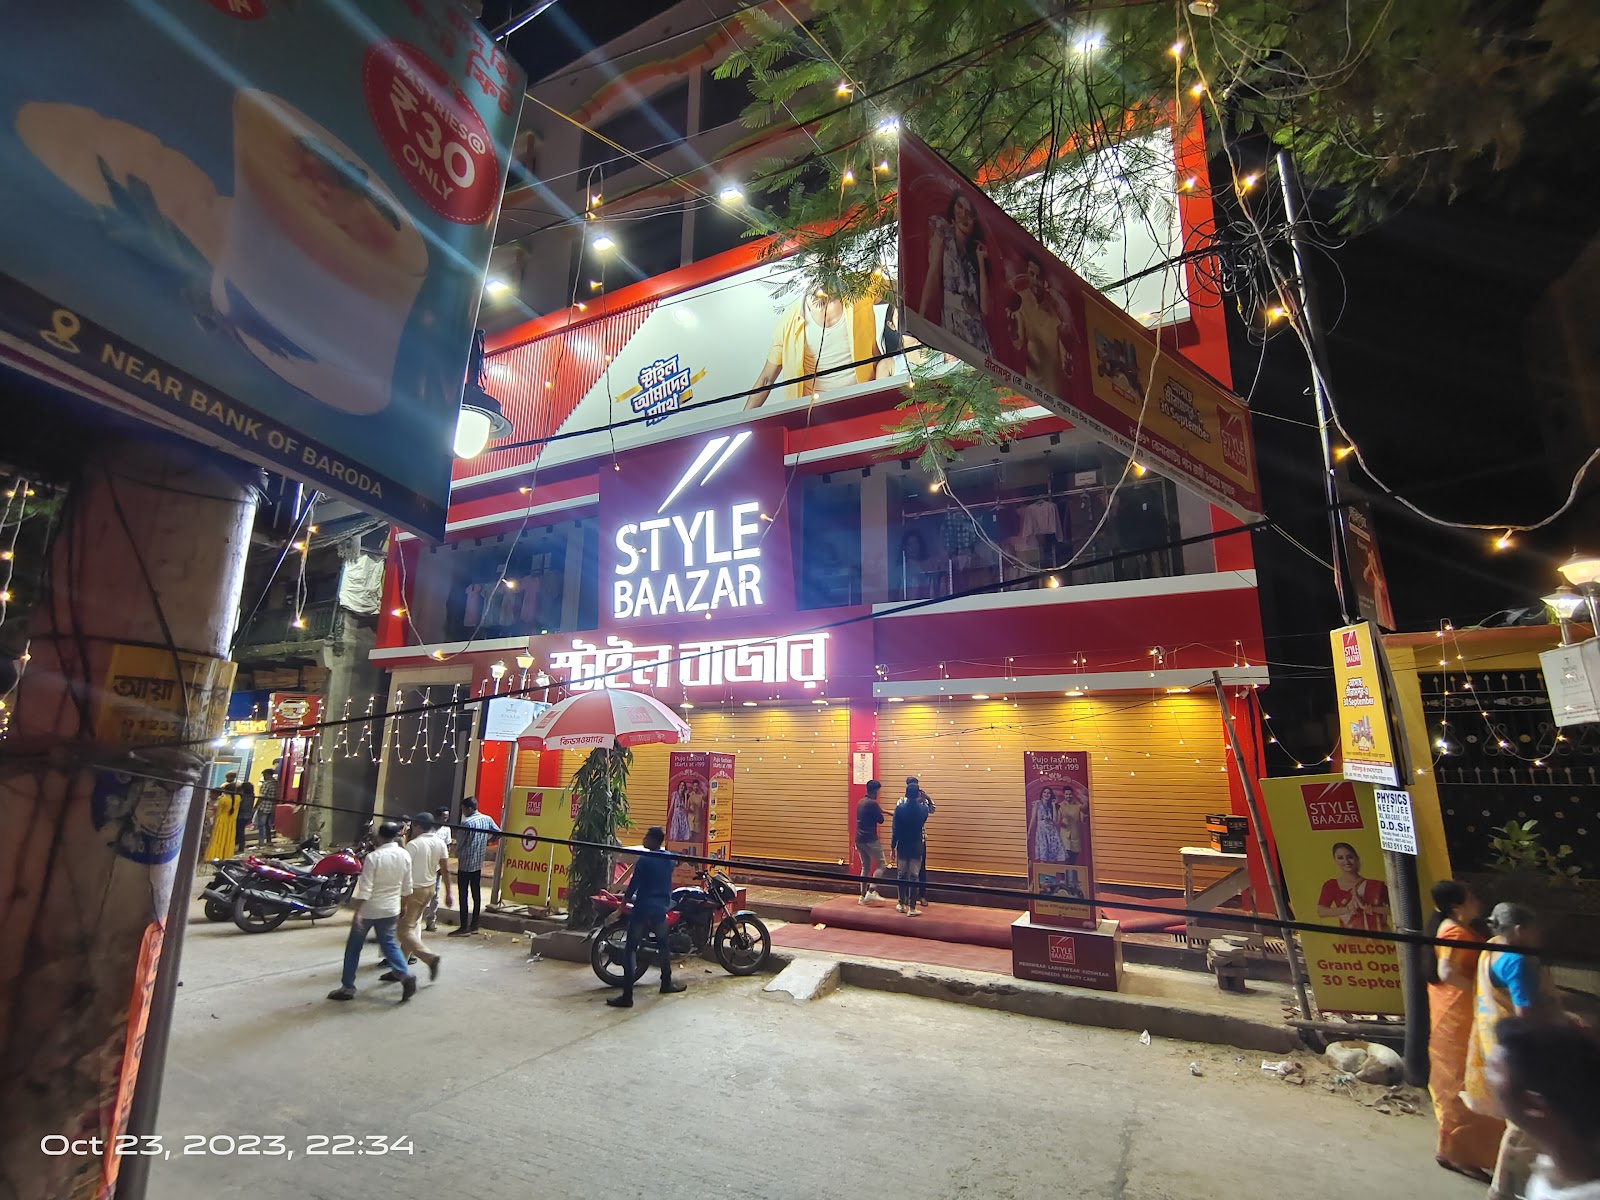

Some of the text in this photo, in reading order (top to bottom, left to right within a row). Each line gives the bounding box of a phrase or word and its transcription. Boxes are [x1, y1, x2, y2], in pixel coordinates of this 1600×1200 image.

[396, 55, 486, 155] PASTRIES@
[389, 75, 476, 189] ₹30
[402, 143, 455, 201] ONLY
[100, 342, 384, 500] NEAR BANK OF BARODA
[1169, 406, 1211, 443] September
[1221, 429, 1245, 456] STYLE
[615, 502, 761, 575] STYLE
[614, 564, 763, 619] BAAZAR
[1345, 644, 1359, 656] STYLE
[550, 632, 830, 691] স্টাইল বাজার
[1349, 697, 1374, 708] September
[674, 755, 686, 763] Pujo
[1032, 755, 1078, 764] Pujo fashion
[1376, 792, 1407, 805] PHYSICS
[1309, 800, 1357, 816] STYLE
[1311, 813, 1360, 826] BAAZAR
[505, 858, 548, 873] PARKING
[1051, 946, 1073, 955] STYLE
[1332, 943, 1397, 956] WELCOM
[1018, 961, 1109, 977] MENSWEAR LADIESWEAR KIDSWEAR
[1316, 959, 1400, 974] Grand Ope
[1321, 974, 1401, 989] 30 Septe
